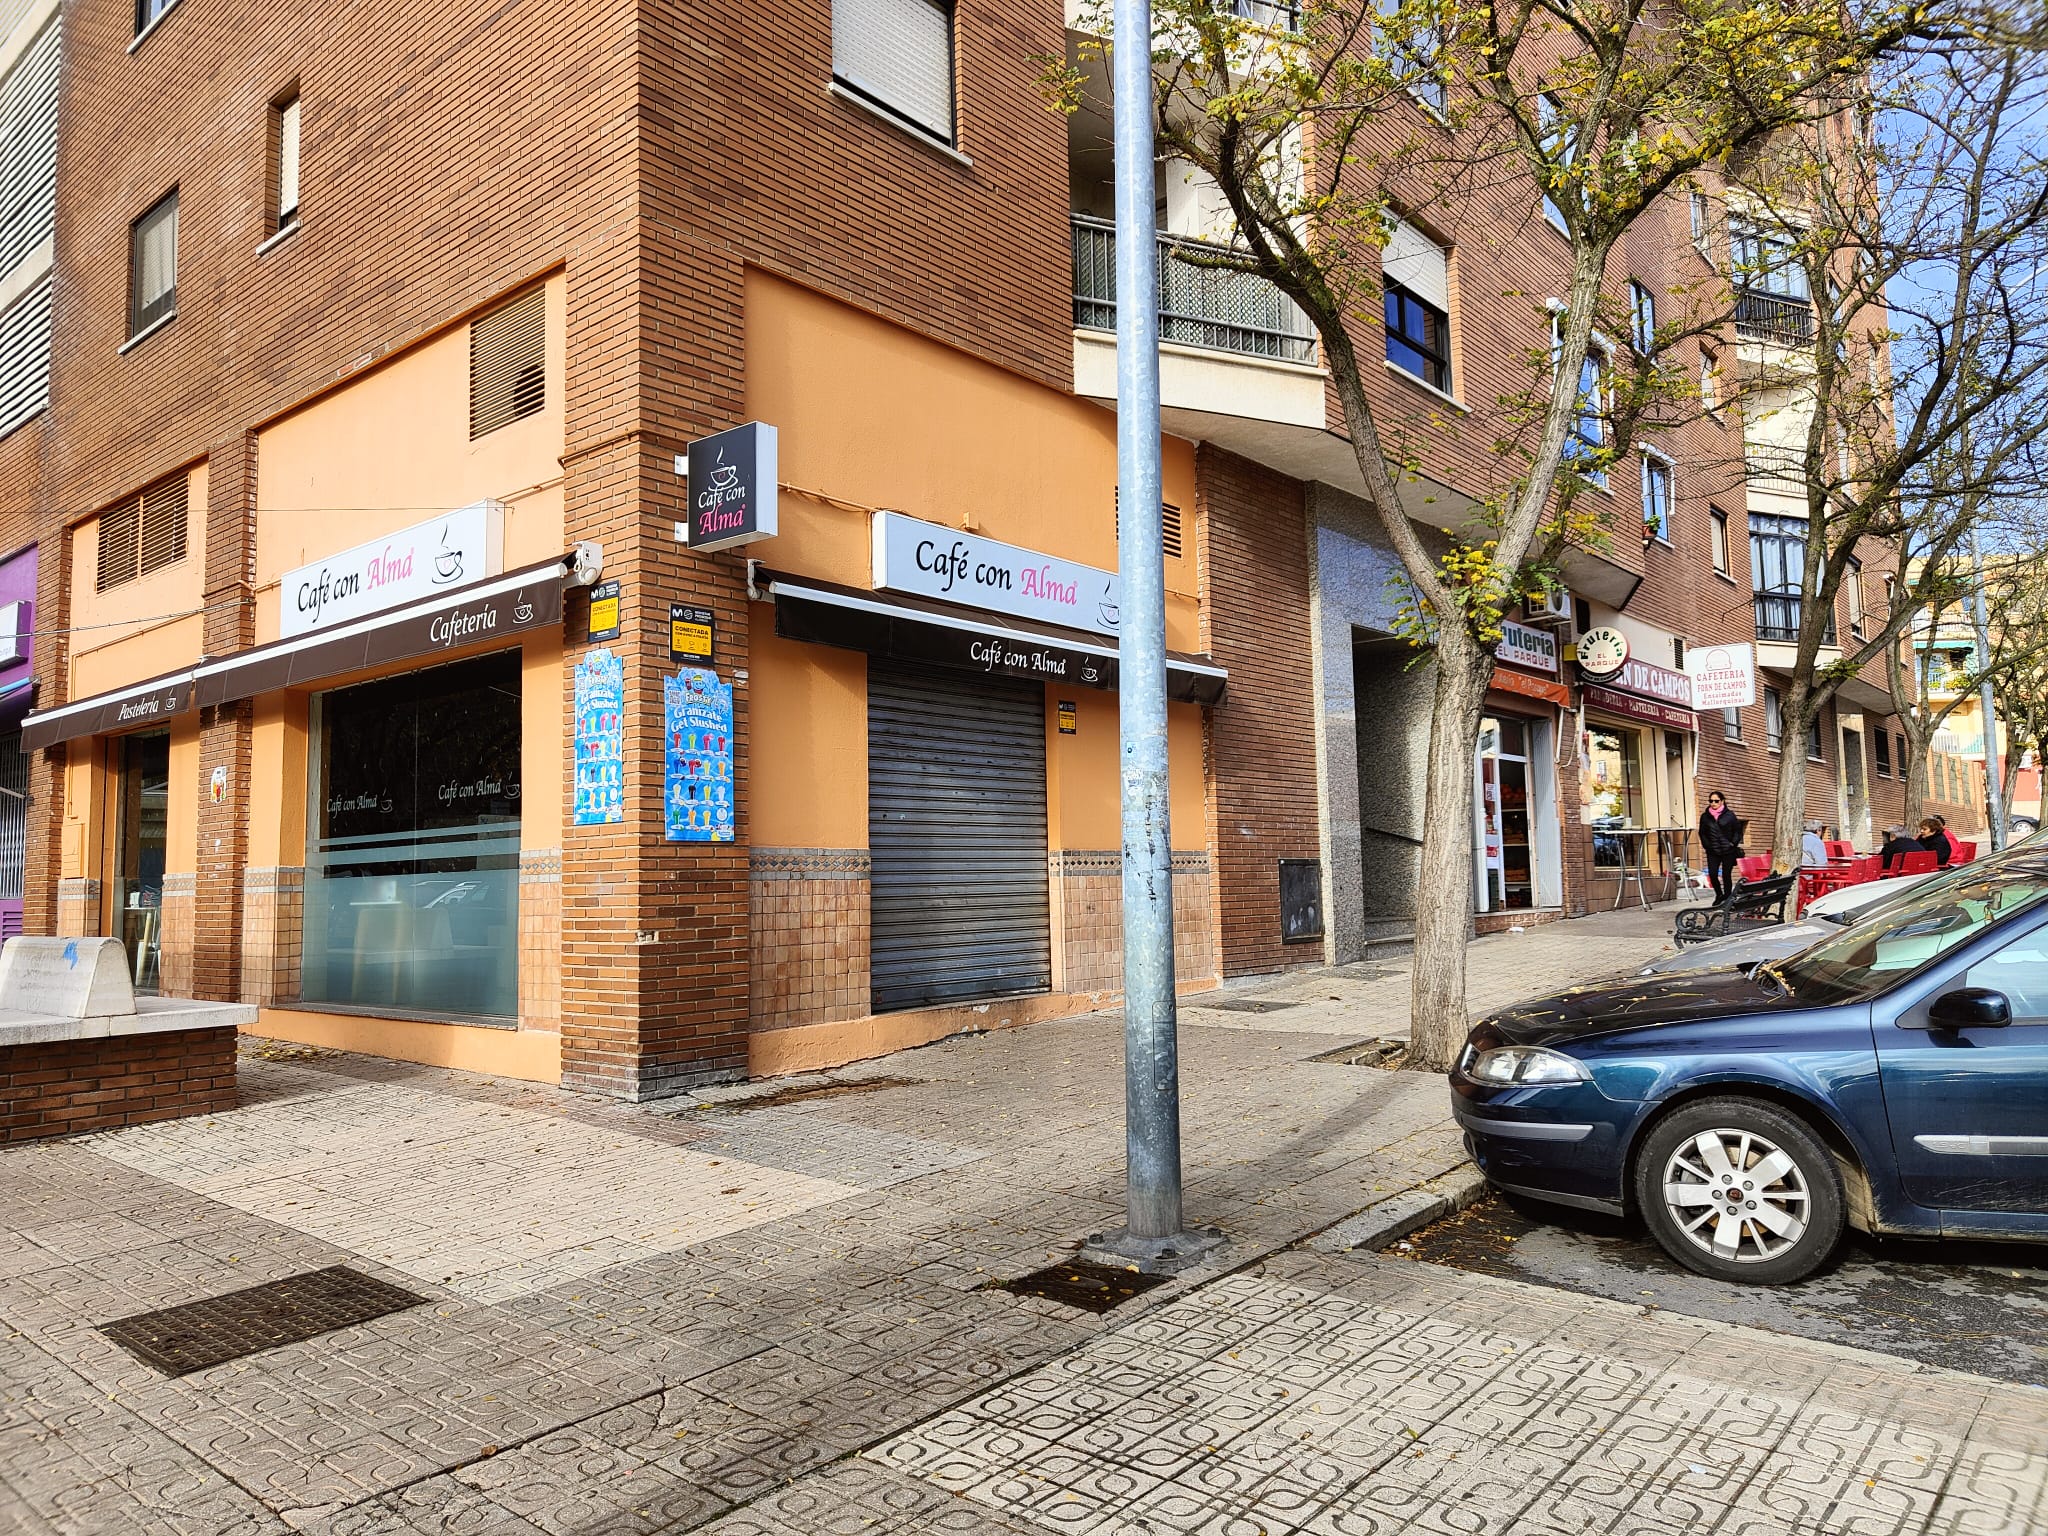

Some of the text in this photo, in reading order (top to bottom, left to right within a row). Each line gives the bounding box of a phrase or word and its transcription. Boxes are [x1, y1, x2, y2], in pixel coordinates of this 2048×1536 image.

[698, 485, 746, 513] Café con
[700, 503, 745, 534] Alma
[297, 545, 415, 624] Café con Alma
[916, 540, 1077, 605] Café con Alma
[430, 604, 497, 646] Cafetería
[675, 625, 709, 636] CONECTADA
[970, 641, 1066, 675] Café con Alma
[1498, 645, 1550, 667] EL PARQUE
[1585, 659, 1619, 667] PARQUE
[1634, 664, 1649, 691] DE
[1650, 670, 1690, 702] CAMPOS
[1696, 670, 1745, 681] CAFETERIA
[1714, 683, 1722, 691] DE
[1723, 681, 1747, 690] CAMPOS
[671, 716, 727, 733] Get Slushed
[438, 775, 501, 807] Café con Alma
[327, 794, 342, 819] Café
[343, 800, 355, 811] con
